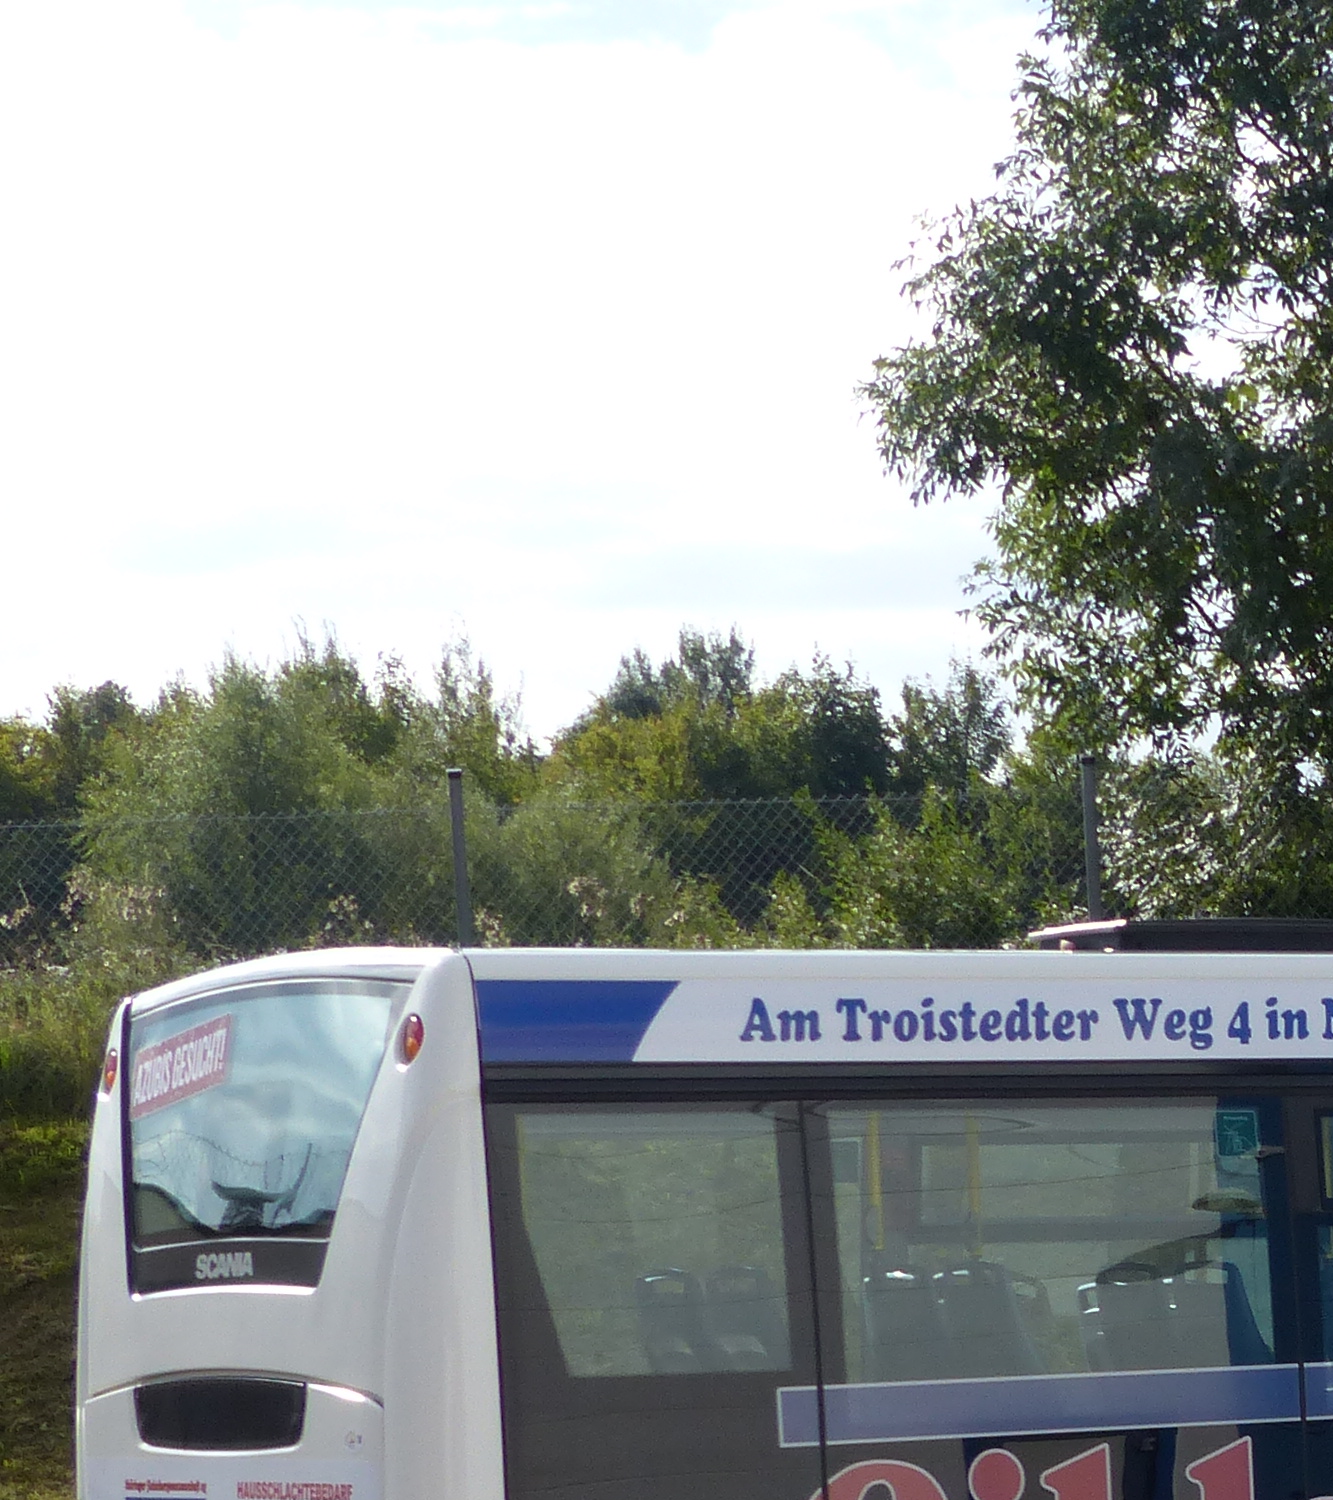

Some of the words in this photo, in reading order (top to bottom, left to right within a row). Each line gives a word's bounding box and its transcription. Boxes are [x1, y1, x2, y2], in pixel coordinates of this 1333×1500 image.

[739, 998, 821, 1042] Am
[836, 997, 1099, 1042] Troistedter
[1112, 998, 1214, 1050] Weg
[1227, 1000, 1252, 1044] 4
[1267, 997, 1309, 1042] in
[195, 1251, 254, 1280] SCANIA
